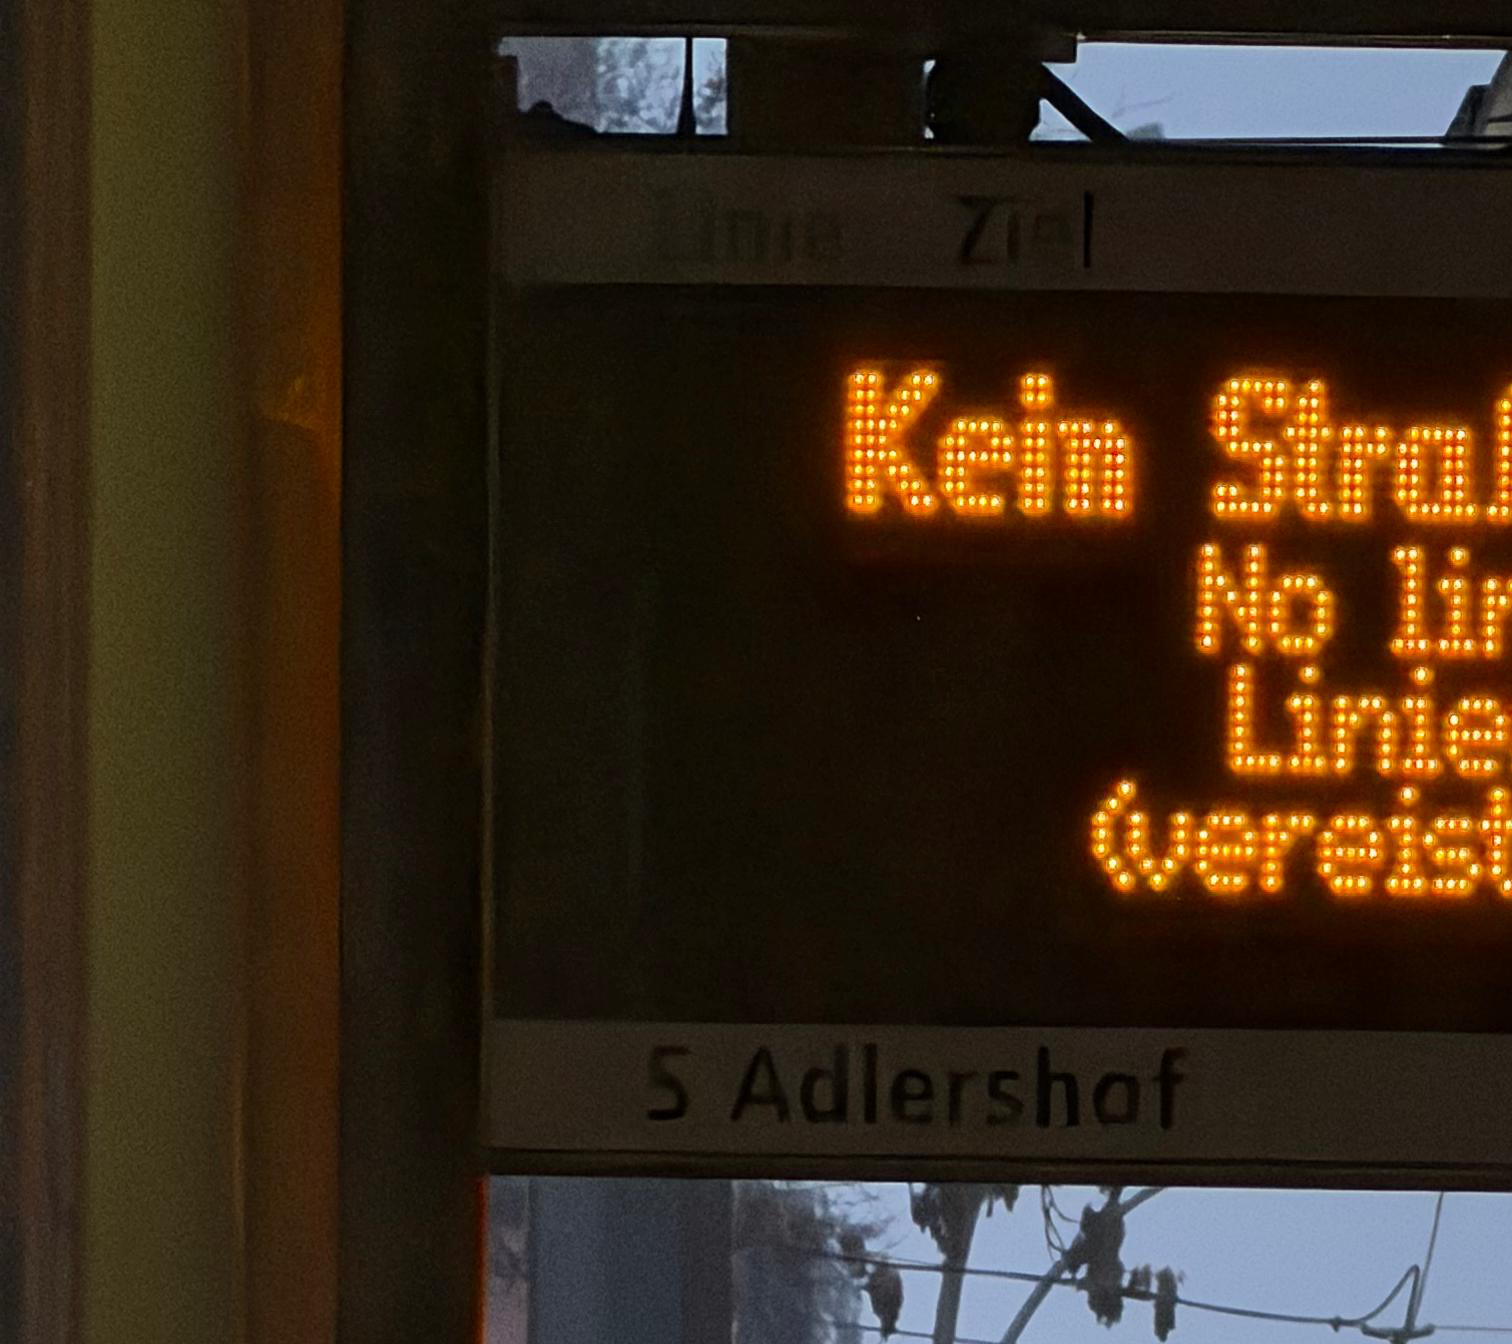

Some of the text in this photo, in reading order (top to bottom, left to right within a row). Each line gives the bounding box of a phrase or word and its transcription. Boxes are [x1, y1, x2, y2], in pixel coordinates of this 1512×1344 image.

[954, 190, 1095, 268] Ziel
[843, 367, 1136, 517] Kein
[1197, 544, 1334, 656] No
[646, 1044, 1191, 1131] S Adlershof
